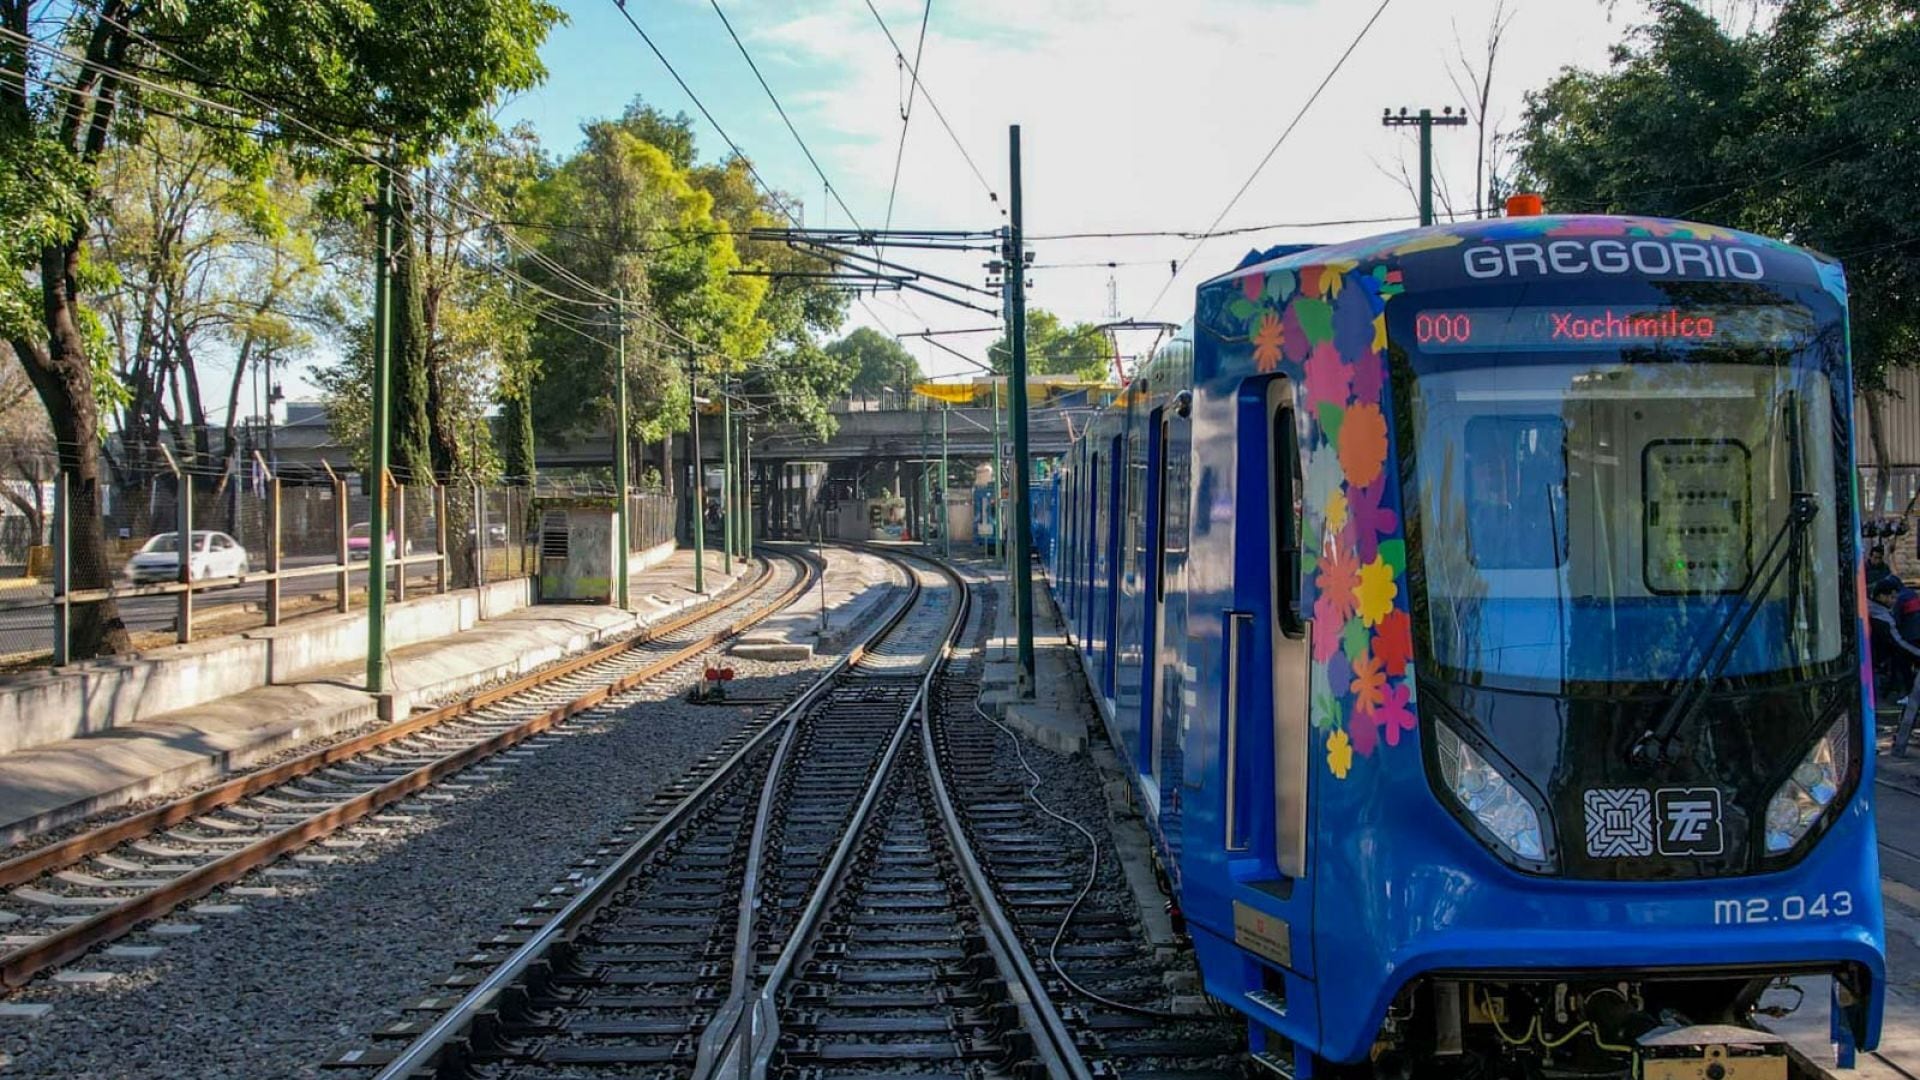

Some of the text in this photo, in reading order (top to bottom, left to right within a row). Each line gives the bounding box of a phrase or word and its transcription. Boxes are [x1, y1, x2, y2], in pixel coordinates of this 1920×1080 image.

[1463, 240, 1765, 280] GREGORIO
[1415, 310, 1714, 343] 000 Xochimilco
